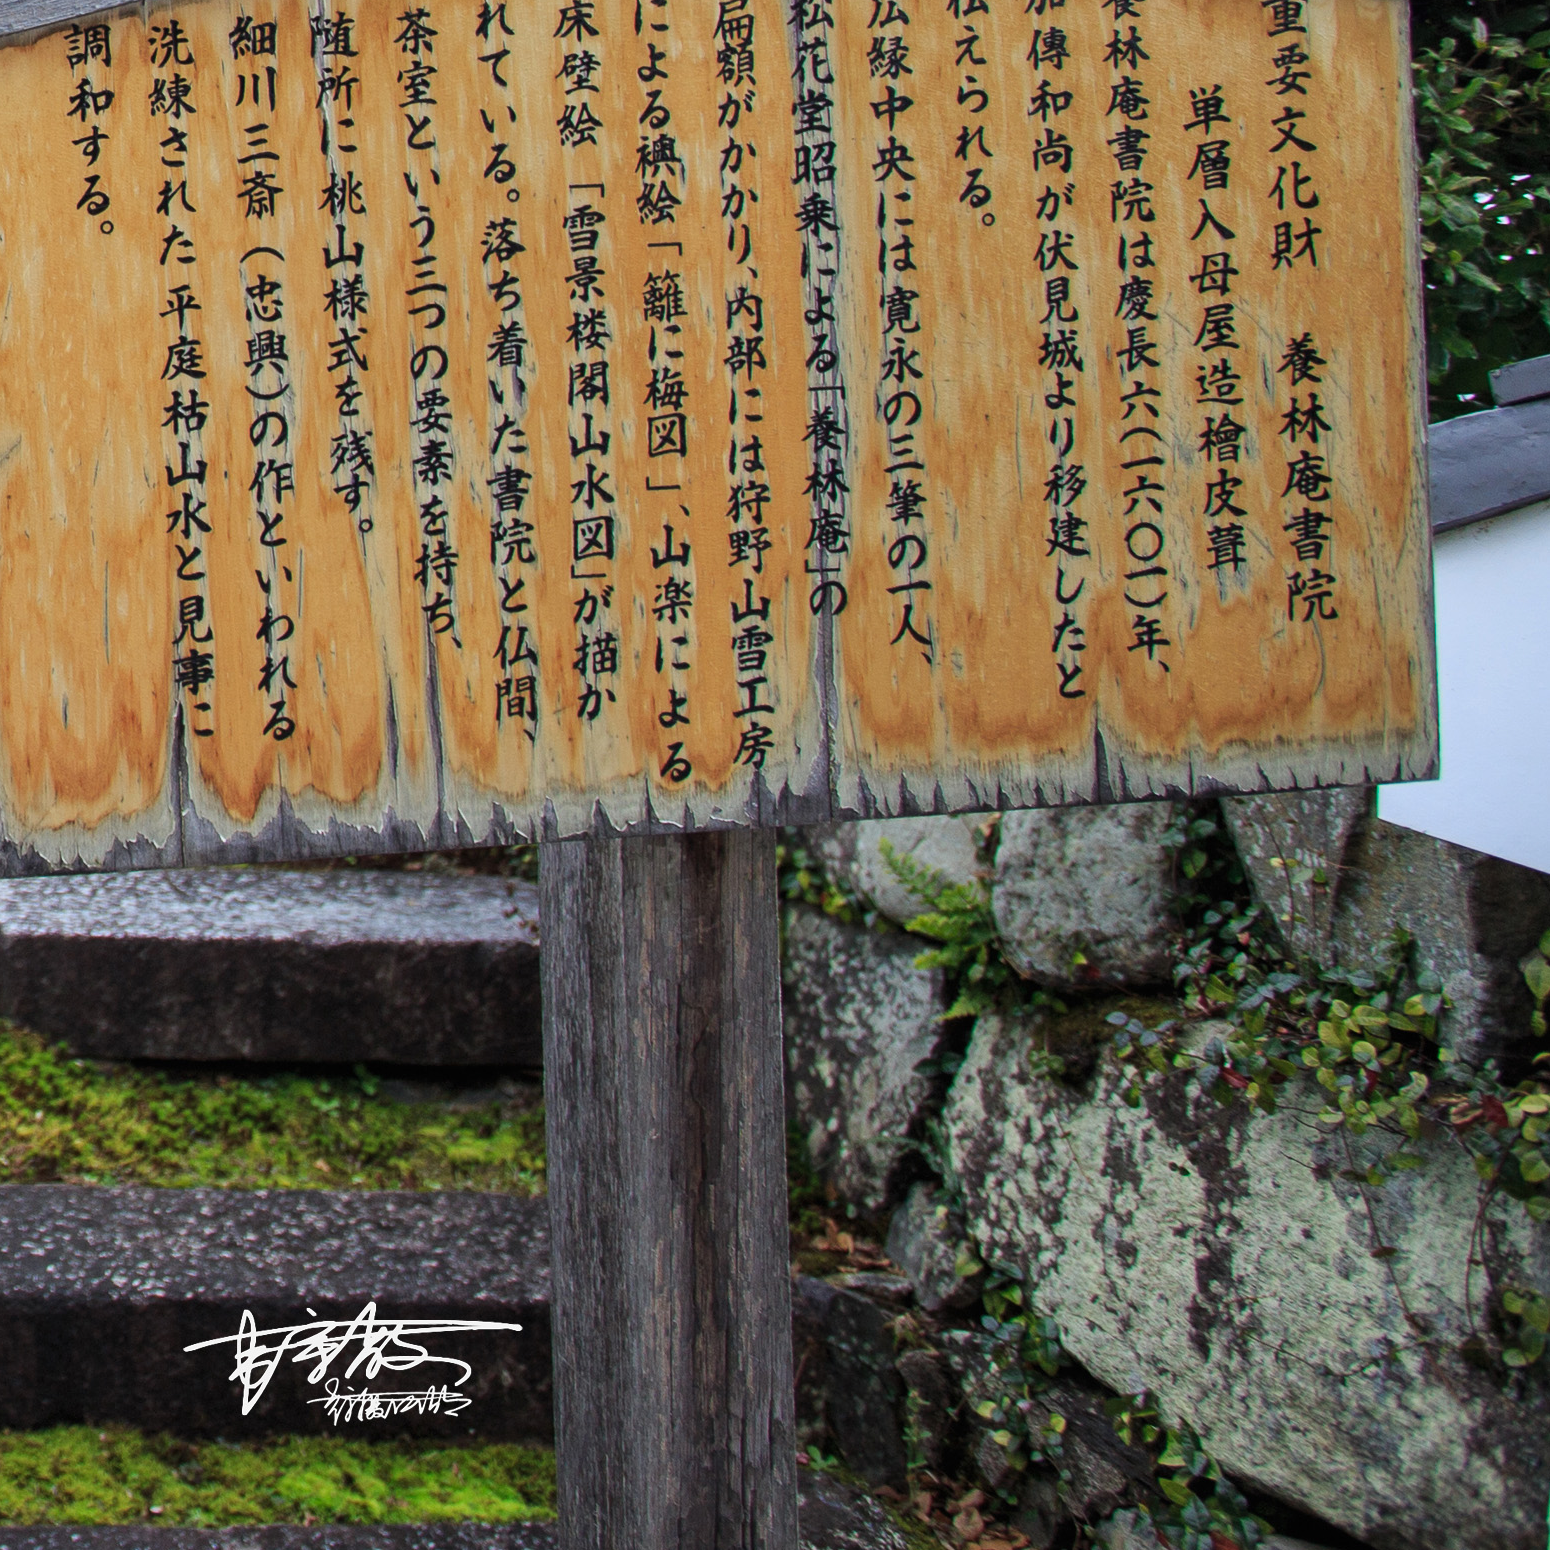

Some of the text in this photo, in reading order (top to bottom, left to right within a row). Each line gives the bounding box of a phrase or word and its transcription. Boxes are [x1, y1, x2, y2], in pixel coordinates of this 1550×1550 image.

[63, 23, 115, 236] 調和する。
[309, 10, 375, 534] 随所に桃山様式を残す。
[393, 7, 462, 649] 茶室という三つの要素を持ち、
[475, 0, 540, 743] れている。落ち着いた書院と仏間、
[1183, 84, 1247, 572] 単層入母屋造檜皮葺
[1277, 331, 1338, 622] 養林庵書院
